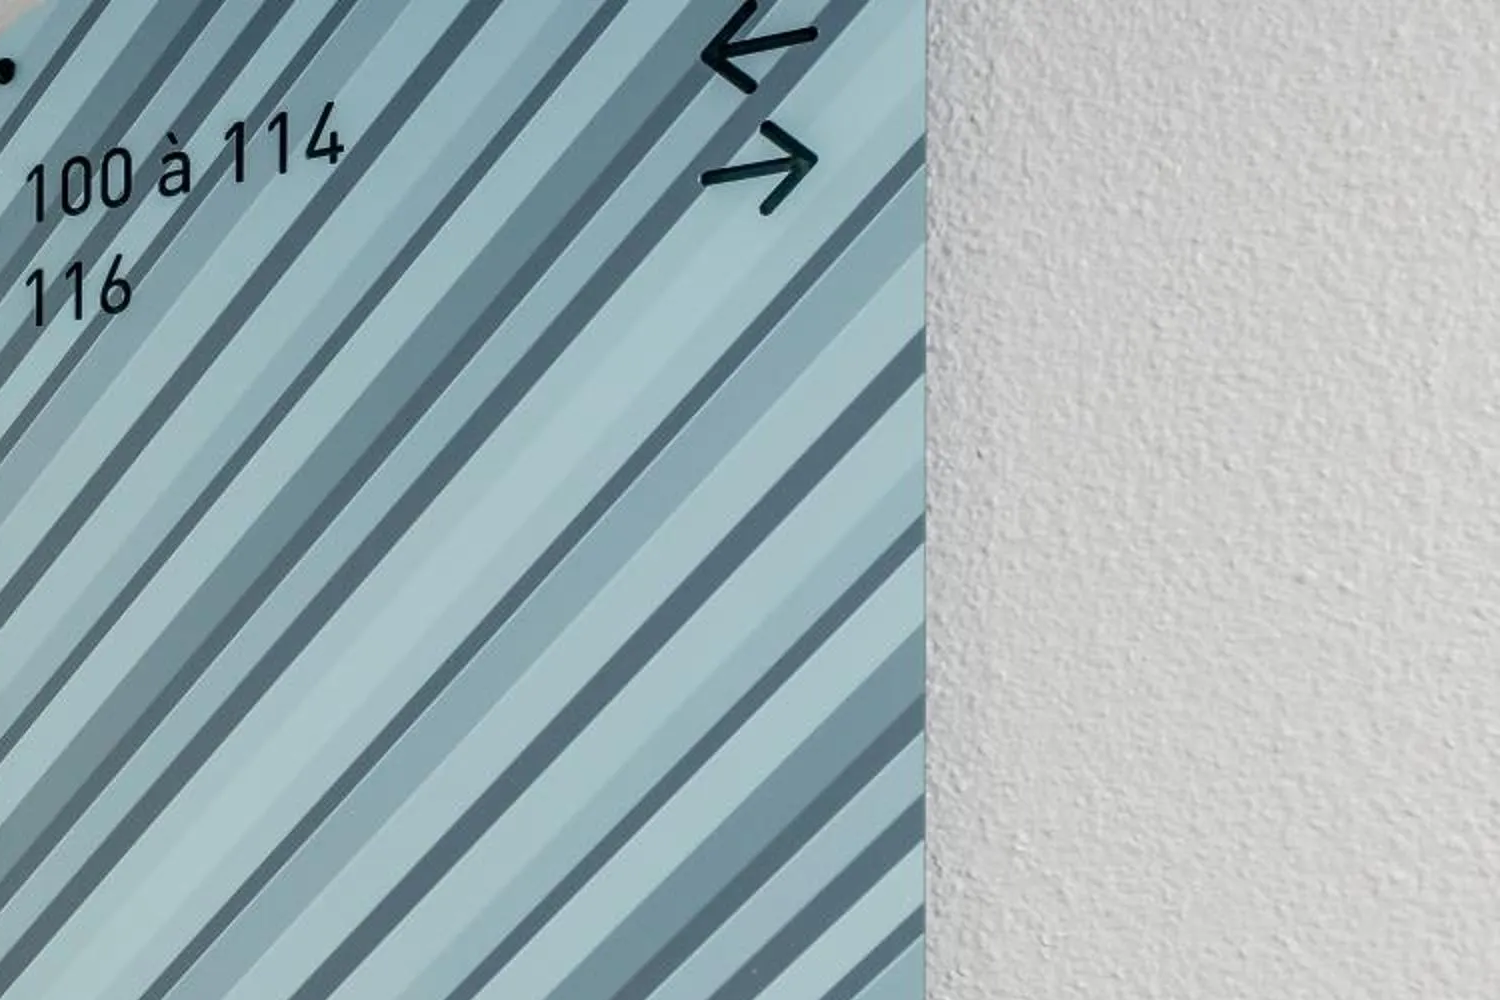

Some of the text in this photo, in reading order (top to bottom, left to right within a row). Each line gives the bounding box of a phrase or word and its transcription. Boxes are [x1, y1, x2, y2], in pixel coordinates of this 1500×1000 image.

[25, 101, 345, 223] 100 à 114
[25, 253, 132, 327] 116
